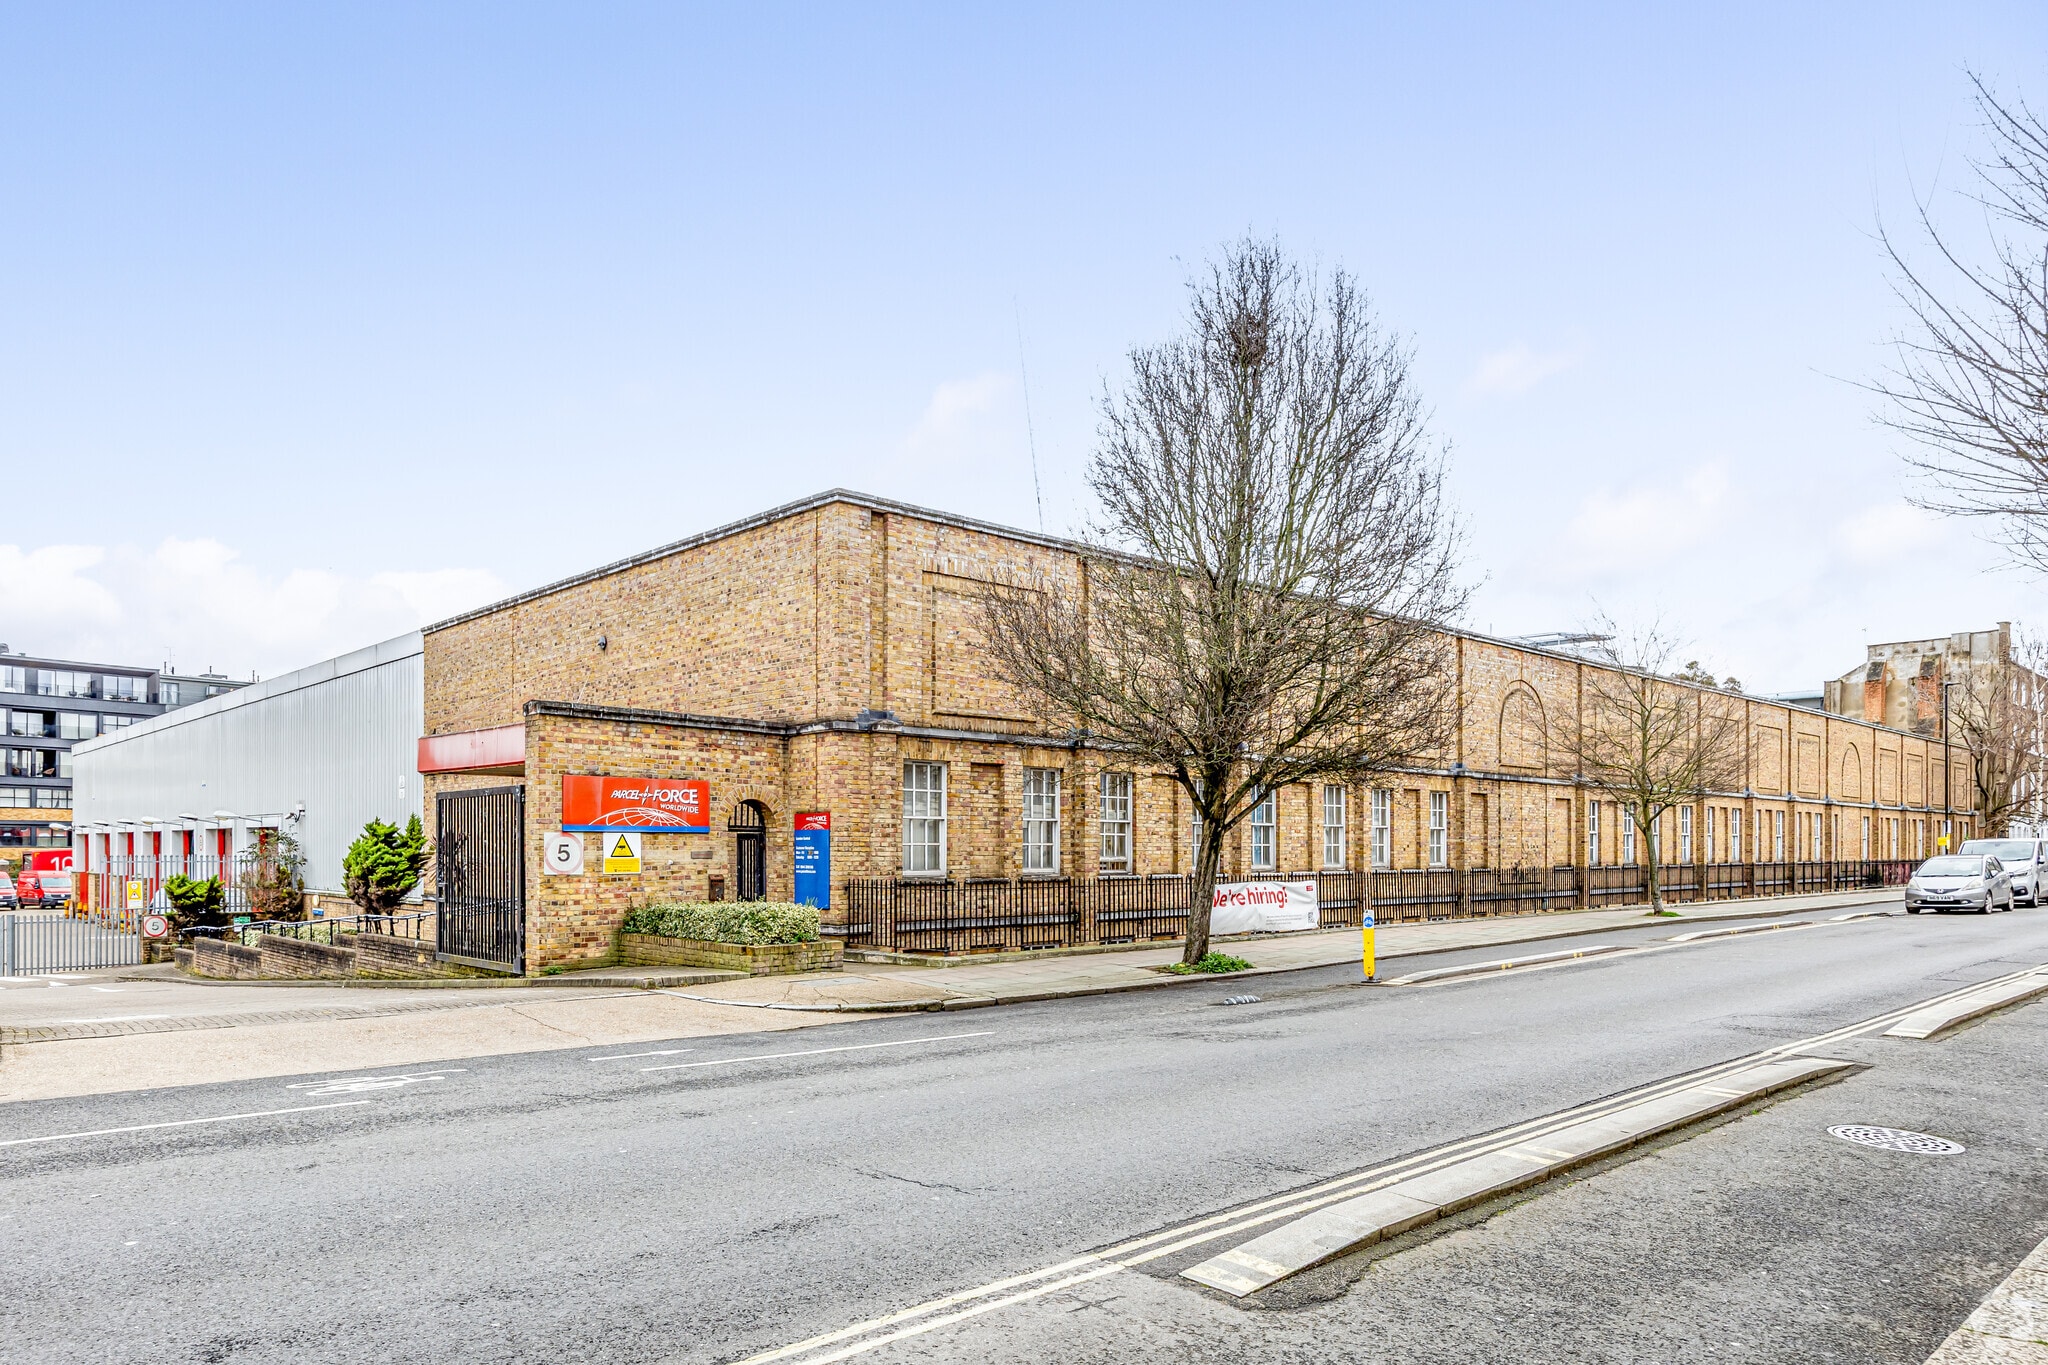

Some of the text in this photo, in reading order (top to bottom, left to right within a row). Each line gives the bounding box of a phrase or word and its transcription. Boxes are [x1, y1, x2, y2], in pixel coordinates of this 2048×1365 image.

[611, 788, 699, 805] PARCEL FORCE
[660, 803, 699, 814] WORLDWIDE
[557, 844, 571, 862] 5
[1246, 886, 1288, 908] hiring!
[151, 921, 160, 931] 5
